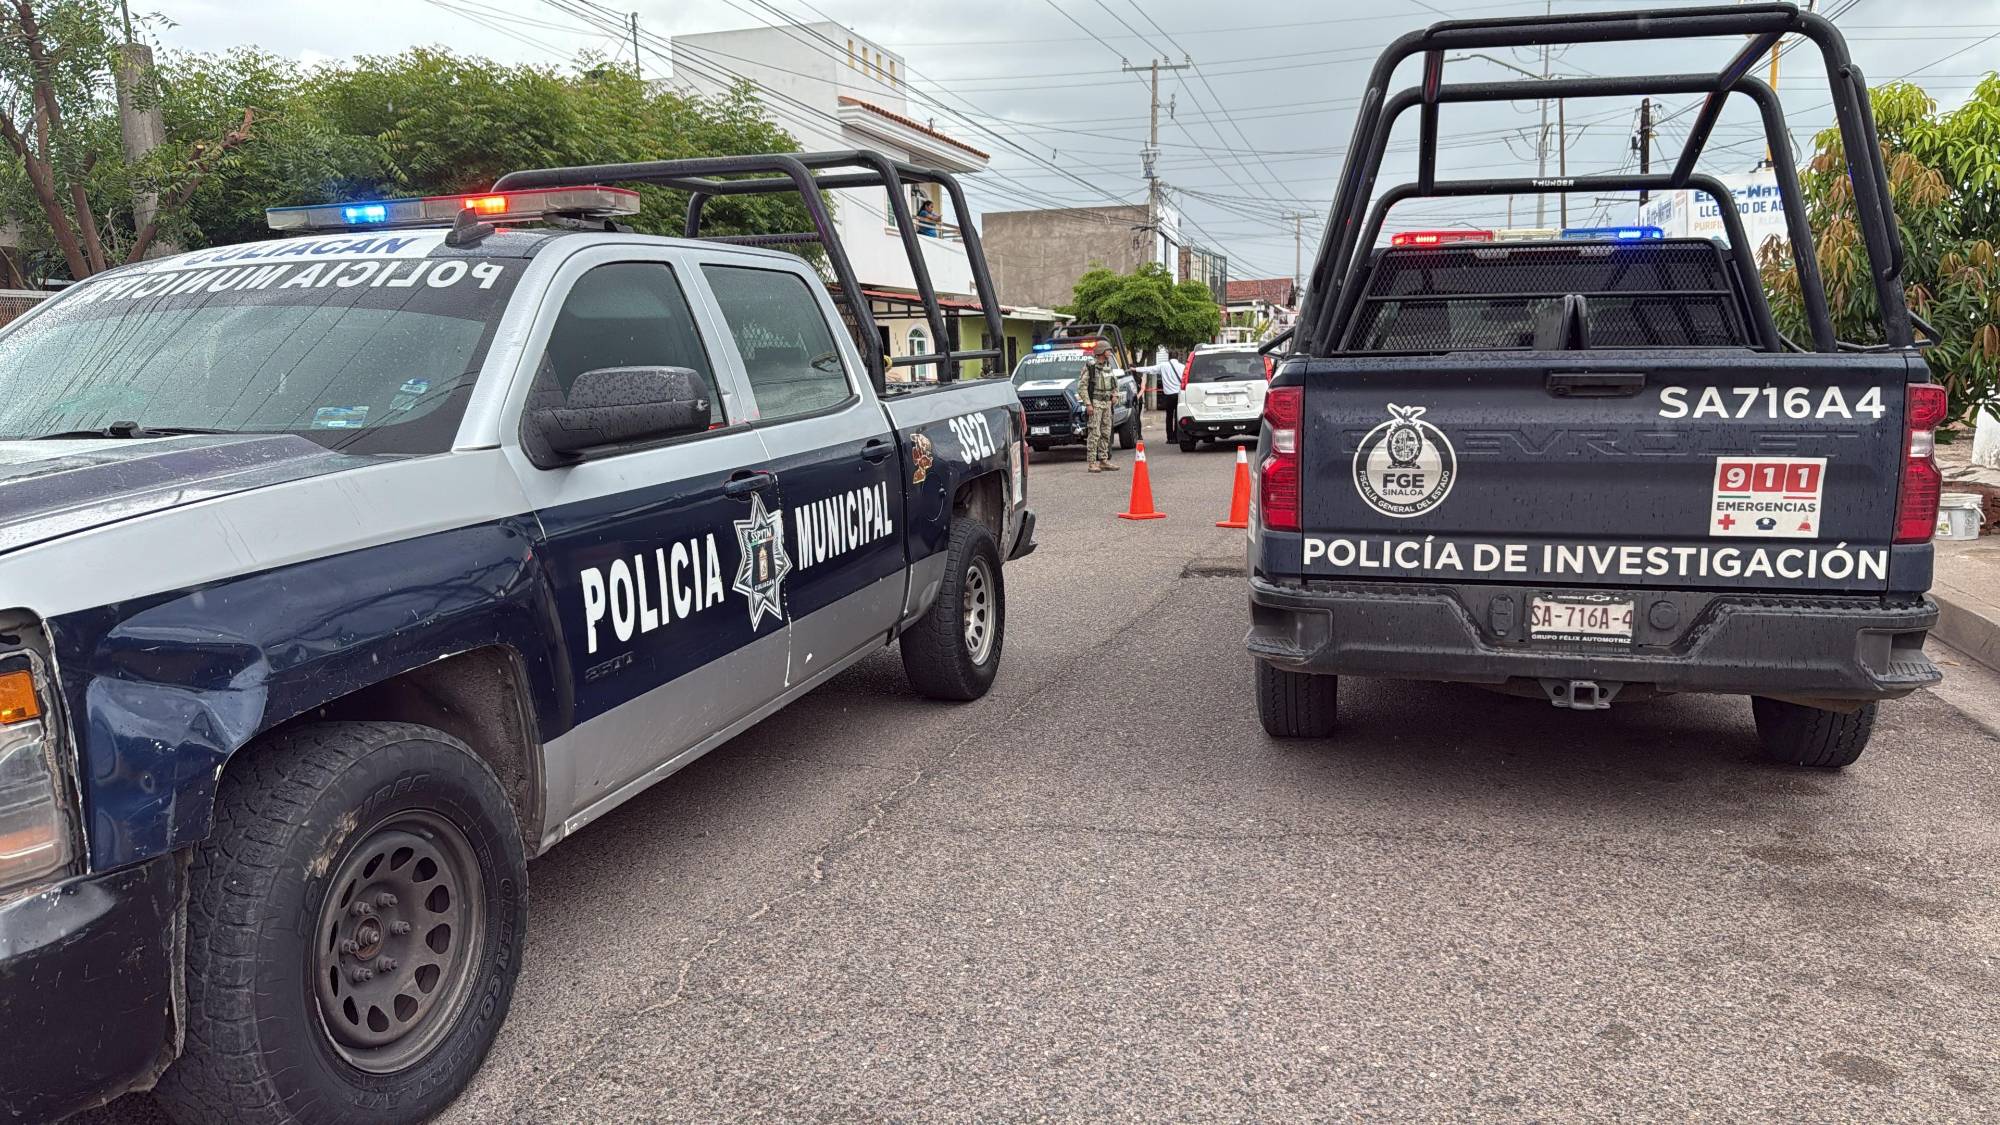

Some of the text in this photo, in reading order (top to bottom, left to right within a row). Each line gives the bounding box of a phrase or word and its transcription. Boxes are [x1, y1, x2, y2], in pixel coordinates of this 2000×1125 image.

[1700, 202, 1749, 217] LLEDO
[1753, 201, 1766, 213] DE
[184, 238, 420, 266] CULIACAN
[1658, 386, 1886, 419] SA716A4
[948, 412, 996, 465] 3927
[1343, 430, 1860, 457] CEVROLET
[1359, 470, 1450, 513] FISCALÍA GENERAL DEL ESTADO
[1382, 473, 1425, 488] FGE
[1716, 501, 1816, 513] EMERGENCIAS
[580, 481, 893, 654] POLICIA MUNICIPAL
[1303, 535, 1888, 580] POLICÍA DE INVESTIGACIÓN
[1531, 604, 1633, 630] SA-716A-4
